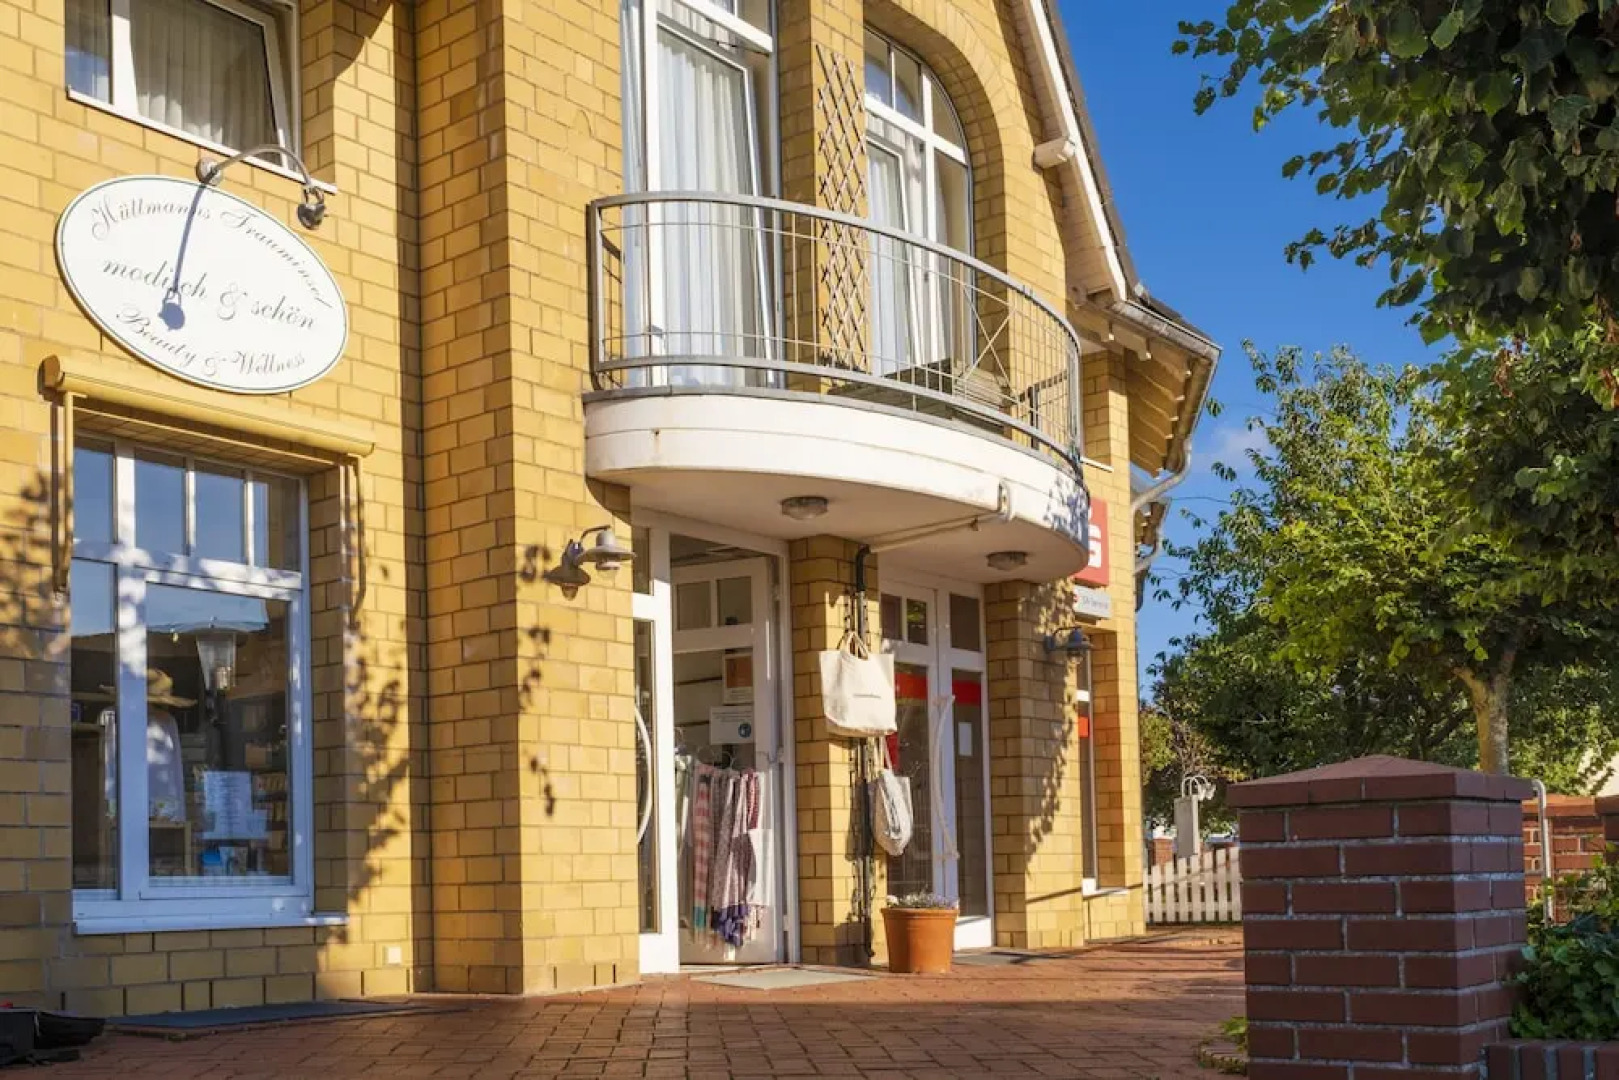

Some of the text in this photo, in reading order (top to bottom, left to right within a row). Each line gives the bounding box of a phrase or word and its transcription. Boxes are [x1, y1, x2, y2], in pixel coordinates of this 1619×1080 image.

[102, 259, 314, 329] modich & schön
[115, 305, 306, 377] Beauty & Wellness
